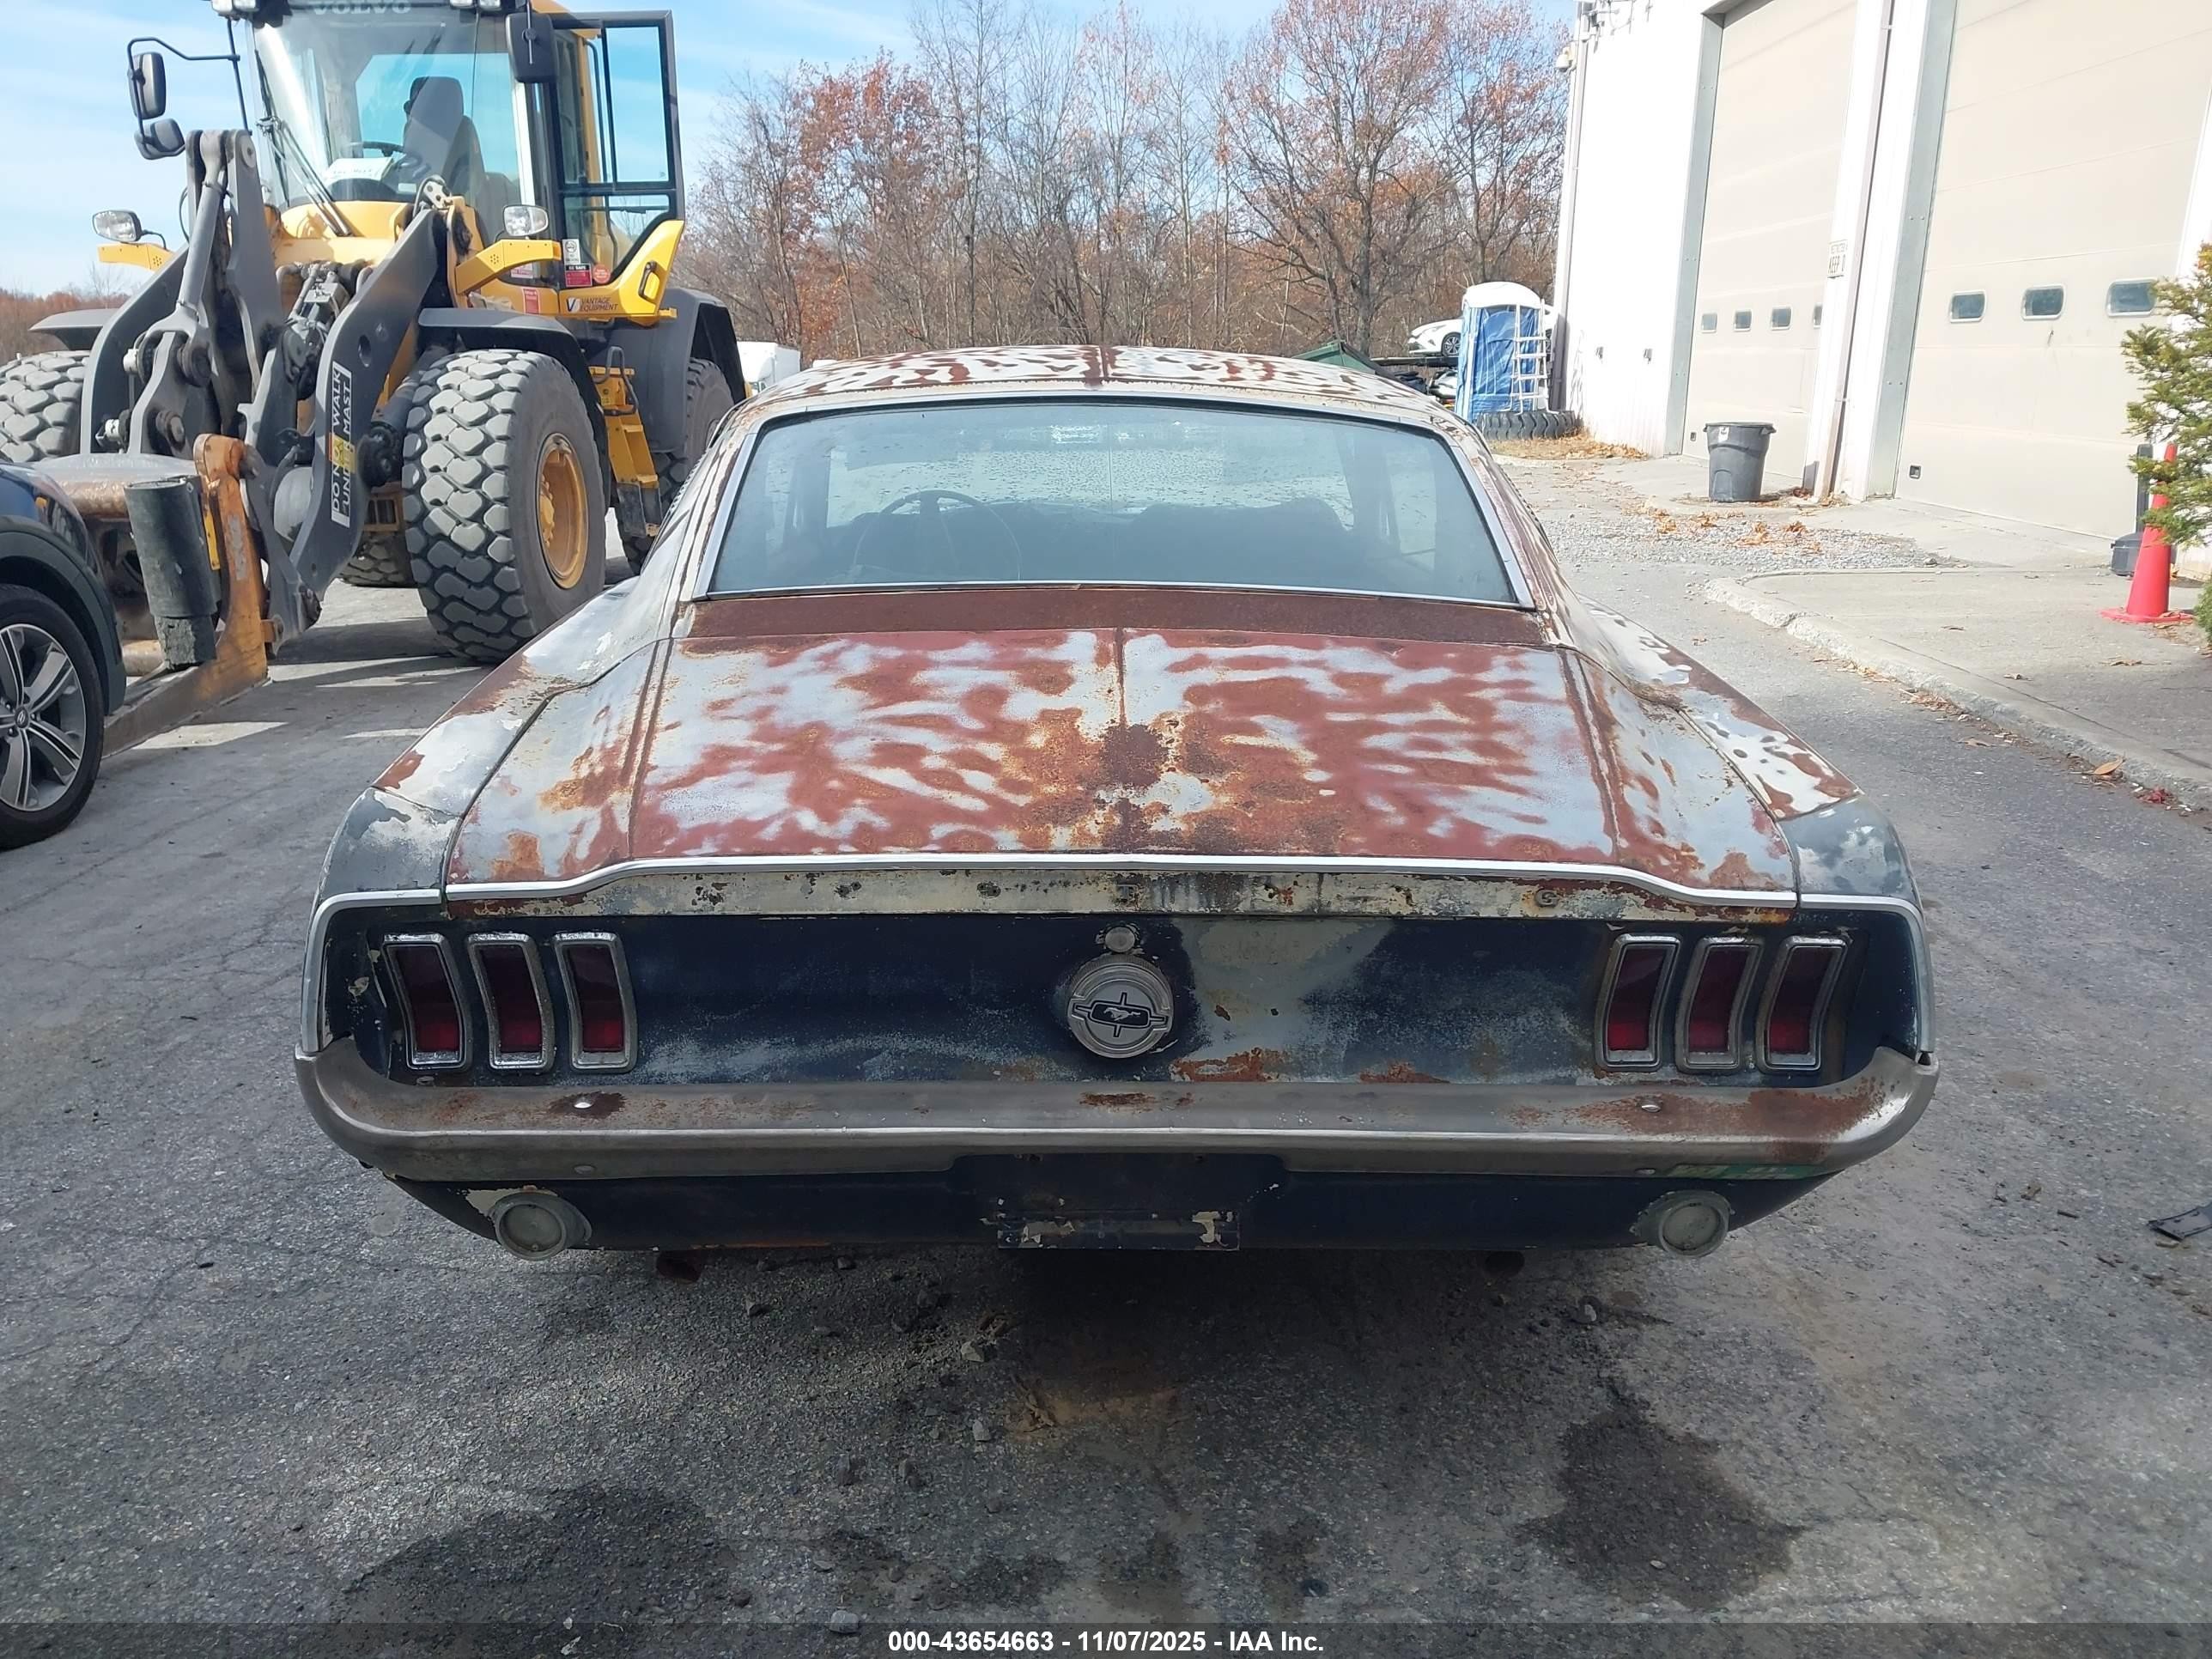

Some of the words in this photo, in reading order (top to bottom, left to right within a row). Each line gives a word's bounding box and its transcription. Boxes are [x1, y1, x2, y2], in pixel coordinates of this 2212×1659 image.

[310, 0, 410, 15] VOLVO
[343, 380, 351, 434] MAST
[343, 441, 351, 506] UNDR
[332, 482, 340, 513] DO
